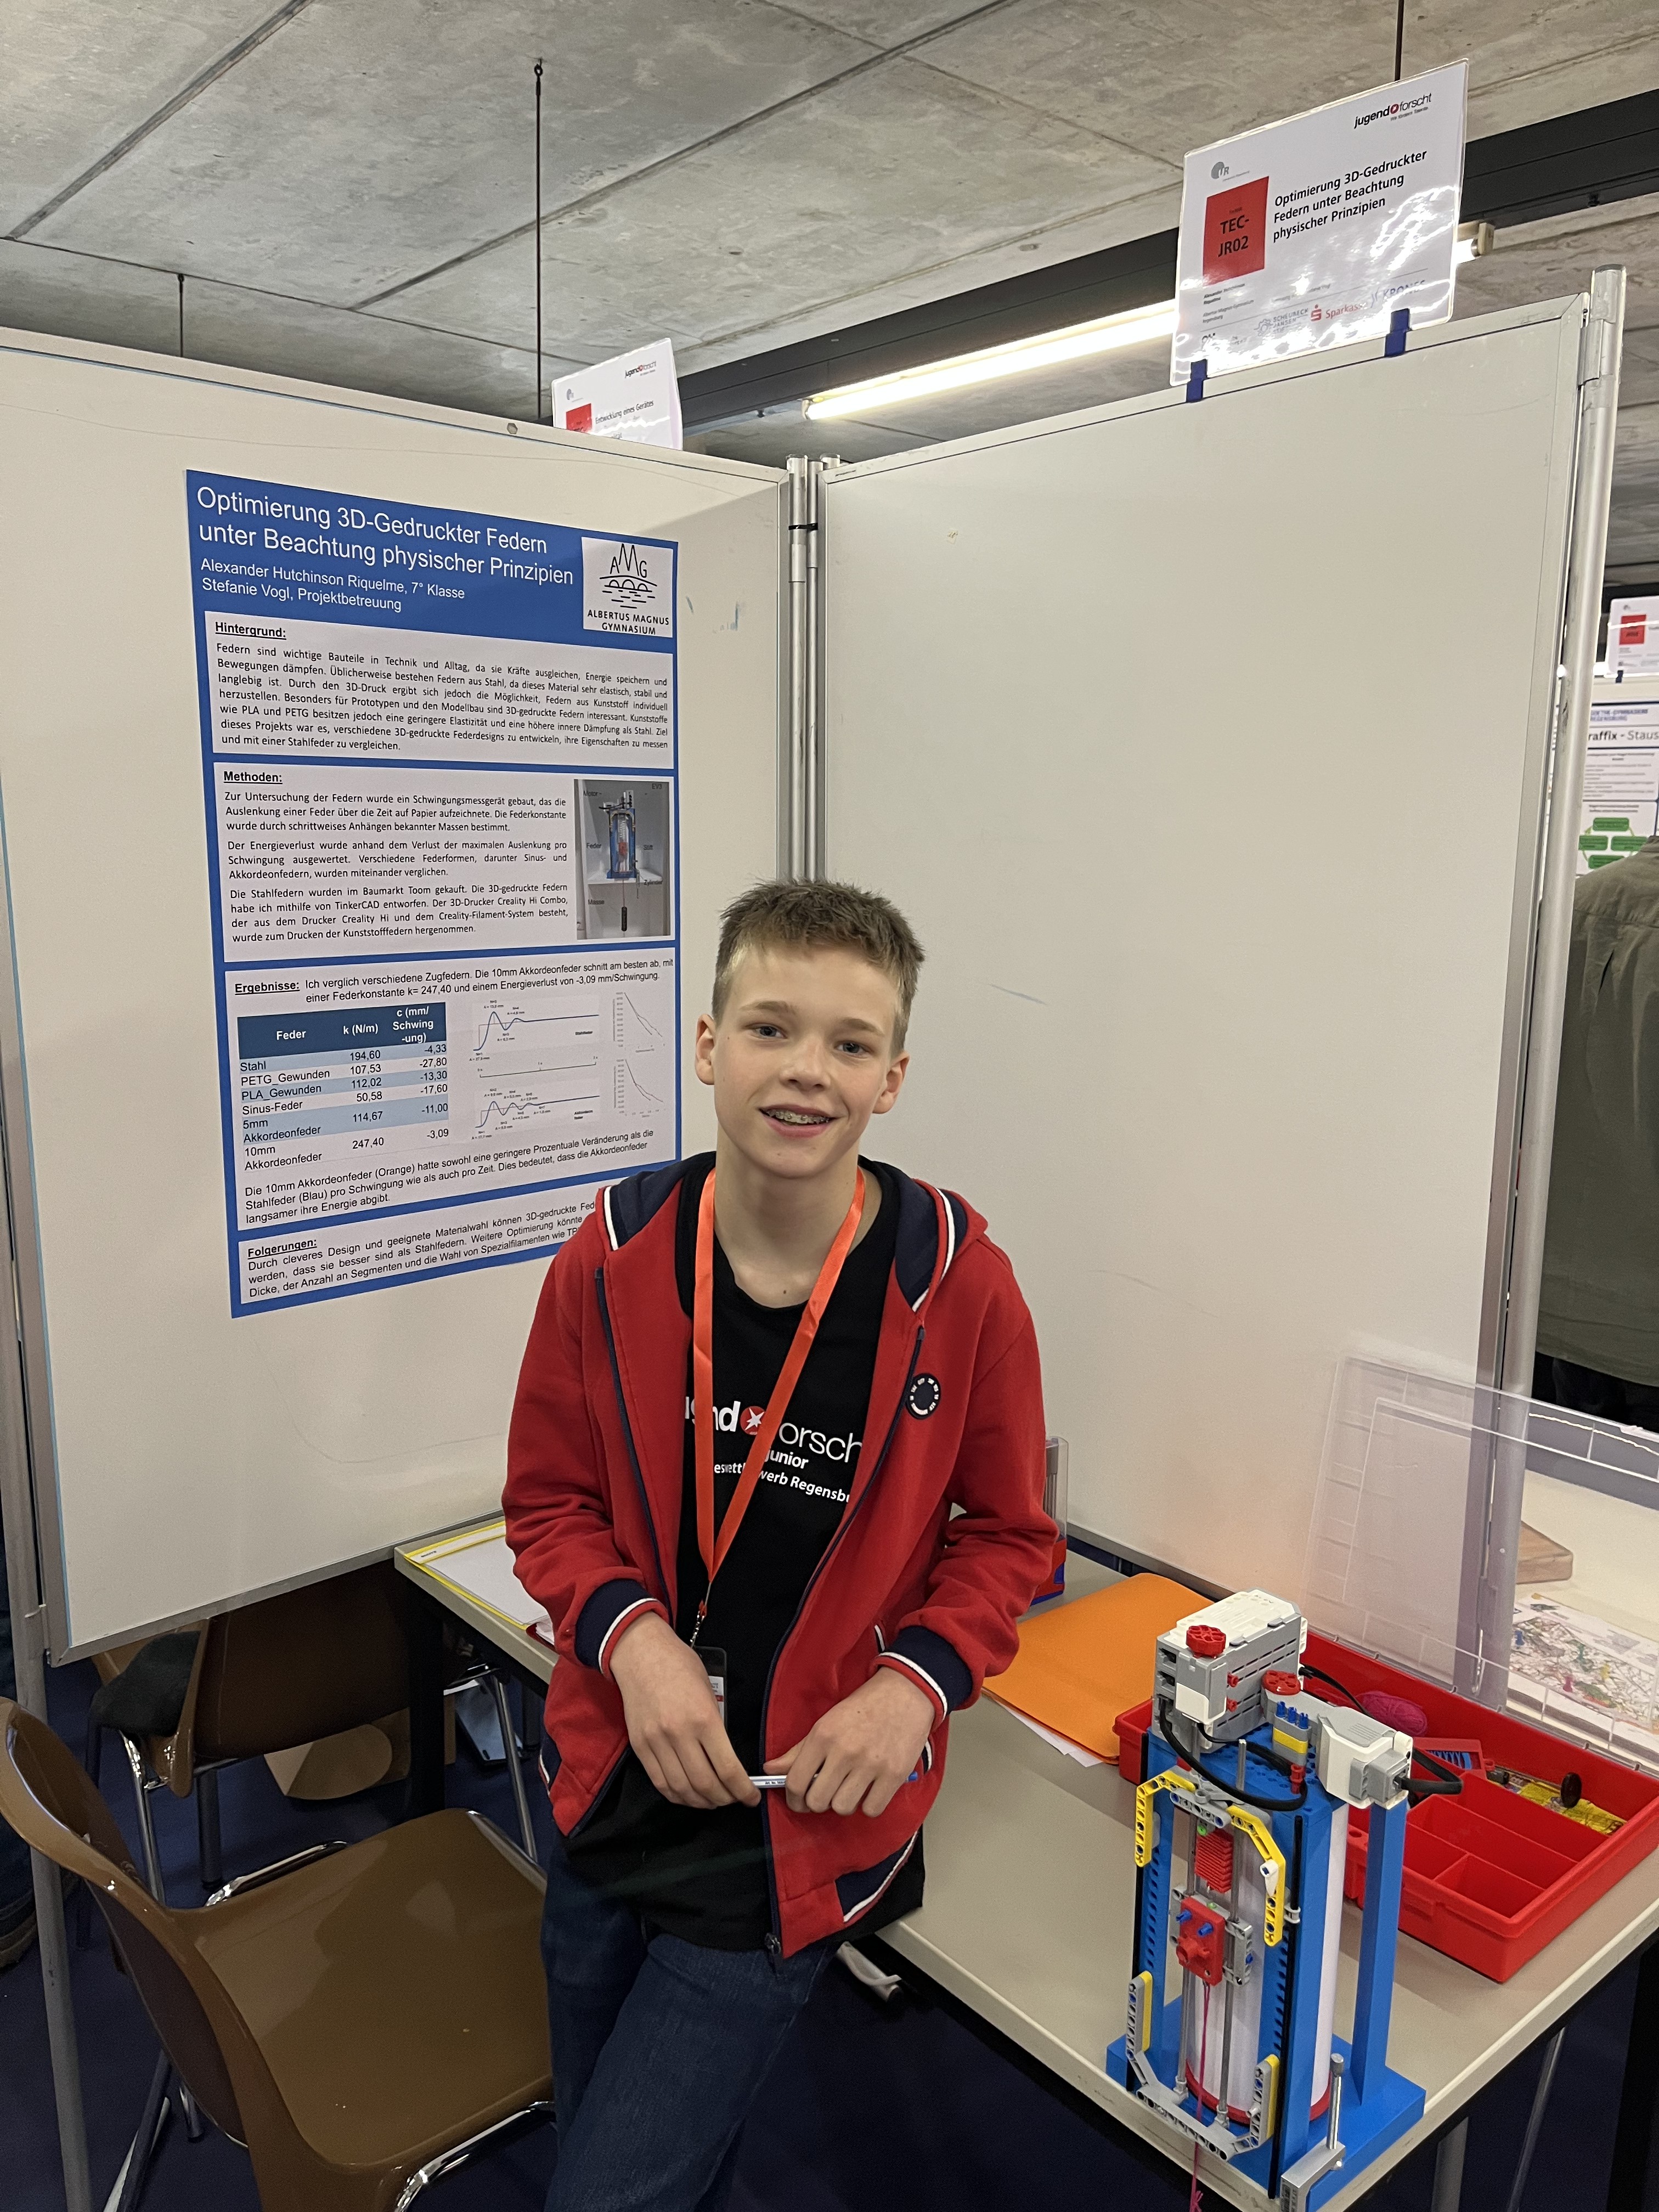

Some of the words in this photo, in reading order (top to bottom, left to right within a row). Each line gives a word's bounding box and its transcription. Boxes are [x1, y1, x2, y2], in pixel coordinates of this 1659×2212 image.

[1354, 105, 1390, 129] jugend
[1399, 93, 1432, 112] forscht
[1275, 178, 1341, 206] Optimierung
[1344, 151, 1427, 184] 3D-Gedruckter
[1274, 205, 1309, 224] Federn
[1313, 194, 1342, 211] unter
[1345, 175, 1404, 201] Beachtung
[1220, 215, 1249, 234] TEC-
[1273, 215, 1328, 242] physischer
[1331, 198, 1385, 222] Prinzipien
[1218, 235, 1249, 258] JR02
[197, 486, 330, 529] Optimierung
[337, 507, 481, 544] 3D-Gedruckter
[487, 528, 547, 554] Federn
[199, 524, 257, 546] unter
[264, 529, 375, 566] Beachtung
[383, 546, 485, 574] physischer
[490, 557, 573, 586] Prinzipien
[201, 558, 269, 578] Alexander
[273, 566, 343, 586] Hutchinson
[348, 574, 407, 595] Riquelme,
[427, 583, 465, 599] Klasse
[202, 577, 257, 596] Stefanie
[261, 584, 293, 601] Vogl,
[298, 588, 401, 613] Projektbetreuung
[587, 609, 630, 622] ALBERTUS
[633, 614, 669, 625] MAGNUS
[215, 621, 287, 641] Hintergrund:
[601, 622, 656, 635] GYMNASIUM
[1588, 730, 1617, 741] raffix
[1627, 730, 1659, 741] Staus
[222, 735, 240, 744] und
[244, 736, 259, 745] mit
[288, 737, 335, 748] Stahlfeder
[348, 740, 400, 751] vergleichen.
[223, 771, 283, 785] Methoden:
[226, 821, 257, 831] wurde
[259, 821, 286, 831] durch
[289, 821, 346, 831] schrittweises
[348, 821, 392, 833] Anhängen
[394, 822, 436, 831] bekannter
[438, 822, 469, 831] Massen
[471, 822, 510, 831] bestimmt.
[305, 979, 320, 989] Ich
[322, 977, 359, 989] verglich
[362, 974, 423, 985] verschiedene
[425, 970, 472, 983] Zugfedern.
[475, 969, 489, 978] Die
[492, 968, 517, 977] 10mm
[518, 964, 582, 976] Akkordeonfeder
[583, 963, 608, 972] schnitt
[623, 961, 648, 969] besten
[650, 960, 661, 968] ab,
[234, 981, 301, 996] Ergebnisse:
[306, 993, 330, 1003] einer
[333, 988, 405, 1001] Federkonstante
[408, 987, 419, 996] k=
[421, 984, 452, 995] 247,40
[454, 983, 470, 993] und
[472, 982, 498, 991] einem
[500, 978, 558, 990] Energieverlust
[576, 975, 596, 985] -3,09
[597, 973, 659, 983] mm/Schwingung.
[405, 1006, 429, 1019] (mm/
[343, 1025, 349, 1035] k
[352, 1023, 378, 1036] (N/m)
[392, 1019, 433, 1030] Schwing
[276, 1030, 306, 1040] Feder
[402, 1032, 426, 1046] -ung)
[350, 1049, 381, 1061] 194,60
[424, 1043, 447, 1055] -4,33
[240, 1060, 266, 1072] Stahl
[350, 1063, 381, 1075] 107,53
[419, 1057, 447, 1068] -27,80
[241, 1069, 330, 1086] PETG_Gewunden
[420, 1070, 448, 1081] -13,30
[351, 1077, 382, 1089] 112,02
[420, 1084, 448, 1094] -17,60
[241, 1084, 321, 1101] PLA_Gewunden
[356, 1091, 382, 1102] 50,58
[242, 1101, 303, 1115] Sinus-Feder
[421, 1103, 448, 1114] -11,00
[353, 1111, 383, 1122] 114,67
[242, 1120, 268, 1130] 5mm
[244, 1126, 321, 1144] Akkordeonfeder
[426, 1128, 449, 1139] -3,09
[352, 1137, 384, 1149] 247,40
[245, 1147, 275, 1157] 10mm
[245, 1153, 322, 1171] Akkordeonfeder
[245, 1186, 262, 1197] Die
[266, 1183, 295, 1193] 10mm
[297, 1171, 373, 1189] Akkordeonfeder
[375, 1163, 415, 1180] (Orange)
[417, 1161, 439, 1171] hatte
[442, 1155, 471, 1167] sowohl
[473, 1154, 491, 1163] eine
[493, 1148, 531, 1161] geringere
[533, 1140, 579, 1154] Prozentuale
[582, 1134, 628, 1146] Veränderung
[246, 1209, 298, 1224] langsamer
[300, 1205, 318, 1215] ihre
[321, 1198, 358, 1212] Energie
[360, 1193, 390, 1206] abgibt.
[248, 1239, 318, 1257] Folgerungen:
[249, 1285, 280, 1297] Dicke,
[283, 1282, 299, 1291] der
[301, 1273, 333, 1288] Anzahl
[336, 1273, 348, 1281] an
[351, 1263, 402, 1278] Segmenten
[405, 1257, 421, 1268] und
[424, 1255, 437, 1265] die
[439, 1250, 461, 1261] Wahl
[463, 1248, 478, 1257] von
[481, 1234, 550, 1255] Spezialfilamenten
[567, 1227, 579, 1237] TP
[778, 1422, 863, 1463] orsch
